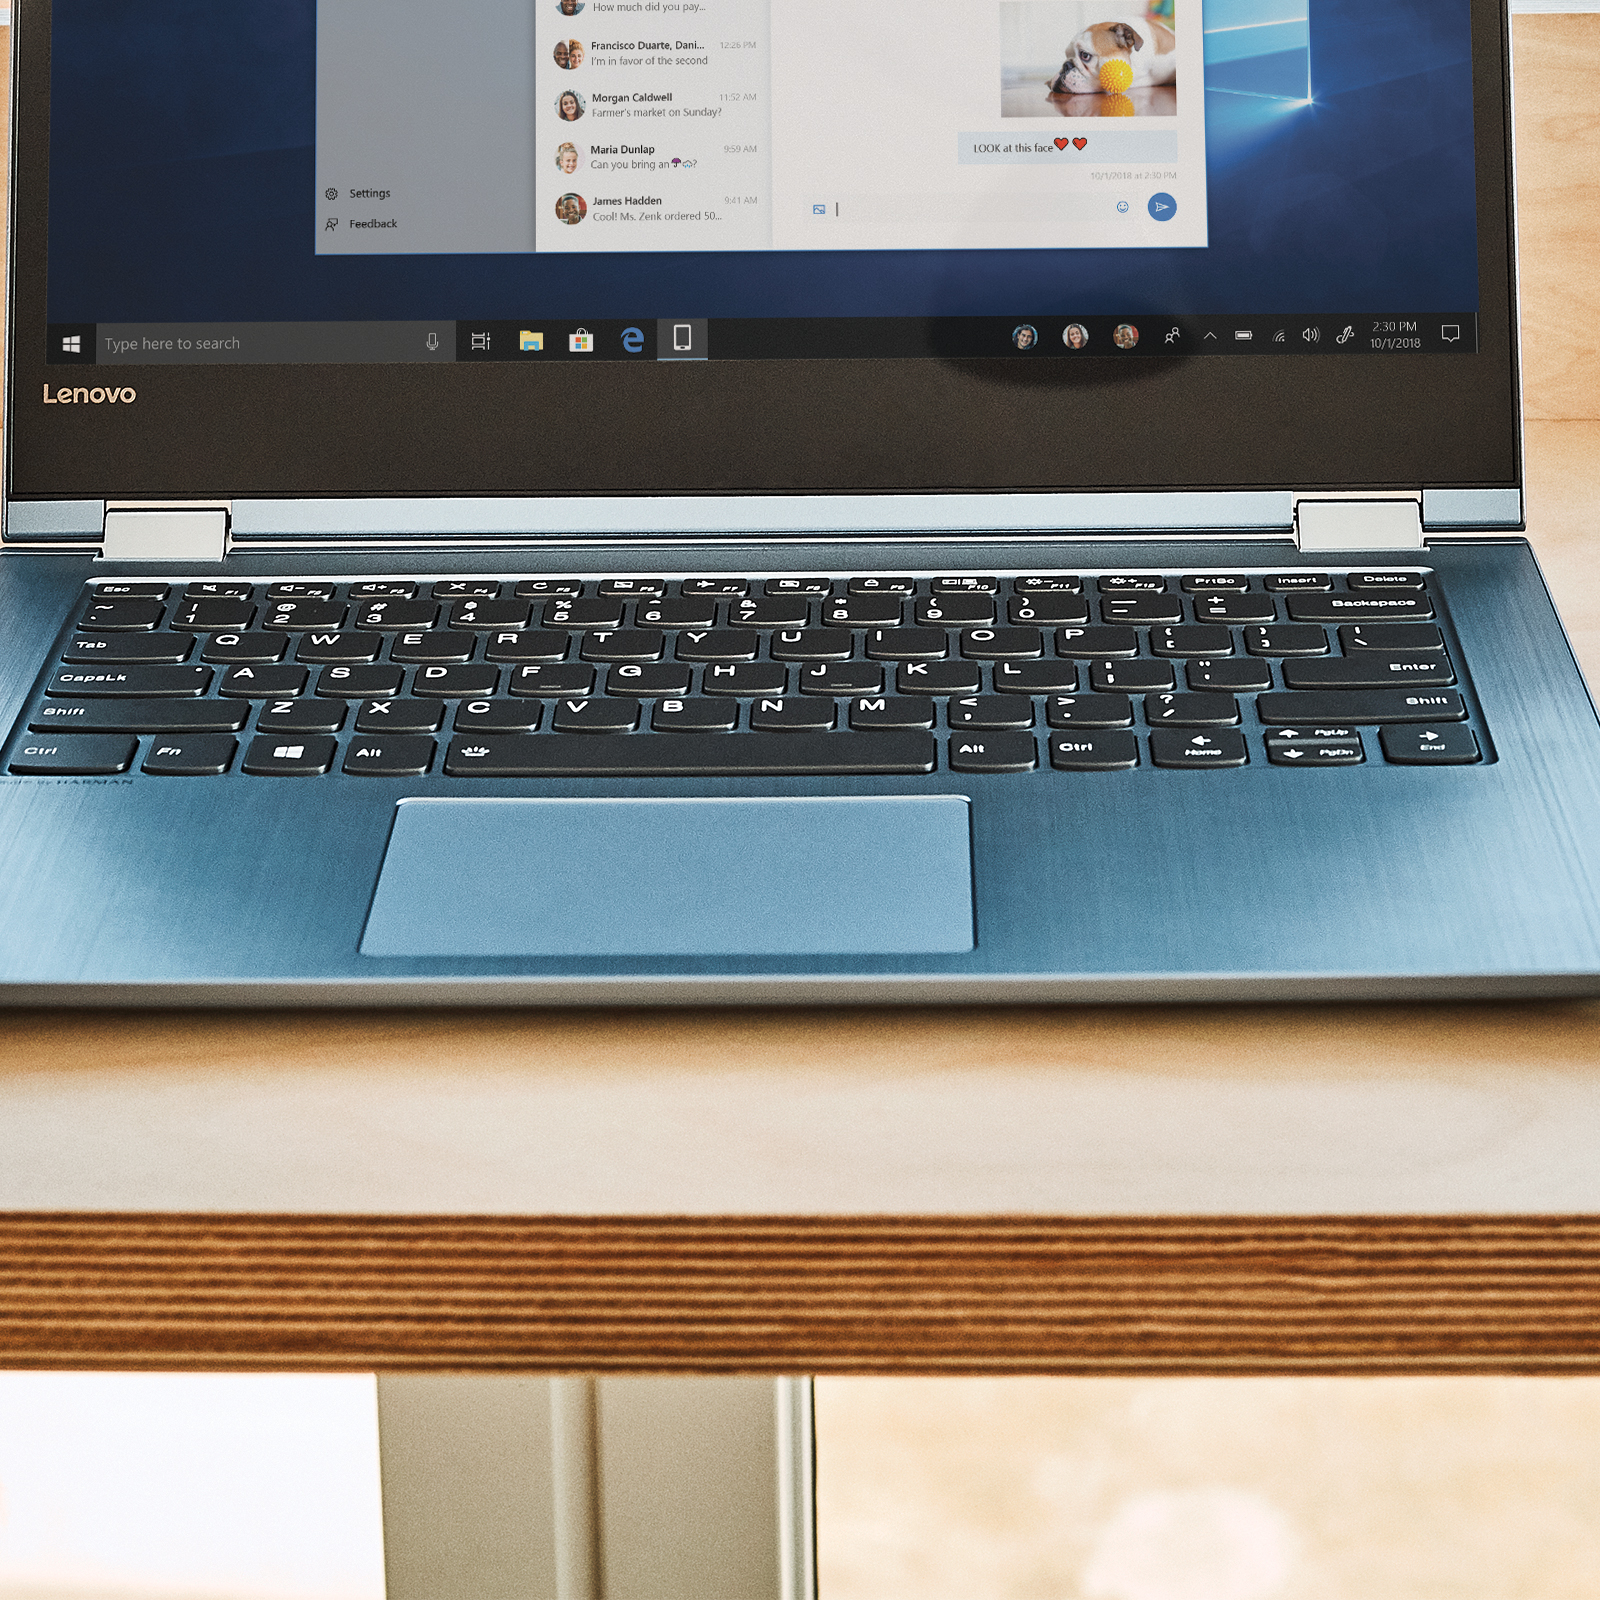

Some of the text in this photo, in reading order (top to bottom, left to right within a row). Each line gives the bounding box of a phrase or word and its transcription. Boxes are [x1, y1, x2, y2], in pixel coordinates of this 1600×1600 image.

[593, 1, 707, 14] How much did you pay...
[591, 40, 705, 51] Francisco Duarte, Dani...
[591, 55, 708, 66] I'm in favor of the second
[592, 92, 673, 105] Morgan Caldwell
[592, 107, 722, 119] Farmer's market on Sunday?
[590, 144, 655, 156] Maria Dunlap
[973, 142, 1054, 154] LOOK at this face
[590, 159, 670, 172] Can you bring an
[349, 187, 391, 201] Settings
[592, 195, 662, 206] James Hadden
[592, 210, 722, 222] Cool! Ms. Zenk ordered 50...
[349, 218, 398, 229] Feedback
[1372, 321, 1417, 332] 2:30 PM
[104, 335, 240, 354] Type here to search
[1369, 337, 1422, 350] 10/1/2018
[43, 383, 137, 404] Lenovo
[1331, 599, 1416, 608] Backspace
[311, 634, 341, 645] W
[403, 633, 424, 645] E
[497, 633, 519, 644] R
[593, 631, 614, 643] T
[686, 632, 708, 643] Y
[781, 627, 805, 643] U
[970, 629, 995, 641] O
[1065, 628, 1085, 640] P
[76, 641, 107, 649] Tab
[215, 634, 240, 646] Q
[1389, 663, 1437, 671] Enter
[59, 674, 127, 683] CapsLk
[1405, 696, 1448, 705] Shift
[43, 707, 85, 716] Shift
[23, 746, 58, 755] Ctrl
[156, 747, 182, 756] Fn
[356, 748, 382, 757] Alt
